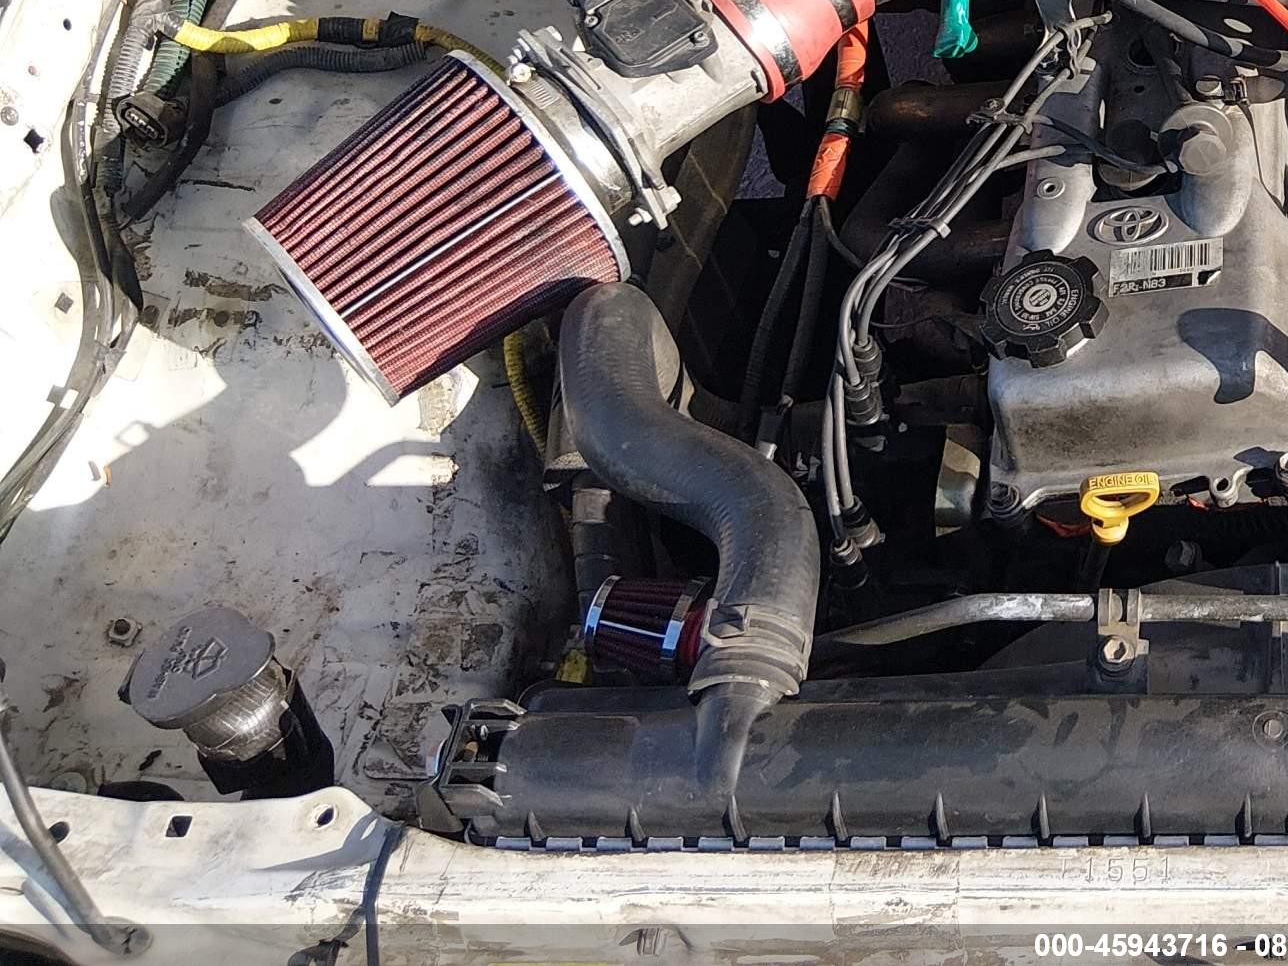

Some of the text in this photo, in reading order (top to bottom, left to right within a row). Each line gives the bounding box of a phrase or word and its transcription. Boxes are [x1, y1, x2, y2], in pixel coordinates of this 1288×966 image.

[1045, 288, 1080, 328] ENGINE OIL
[1089, 473, 1154, 491] ENGINE OIL
